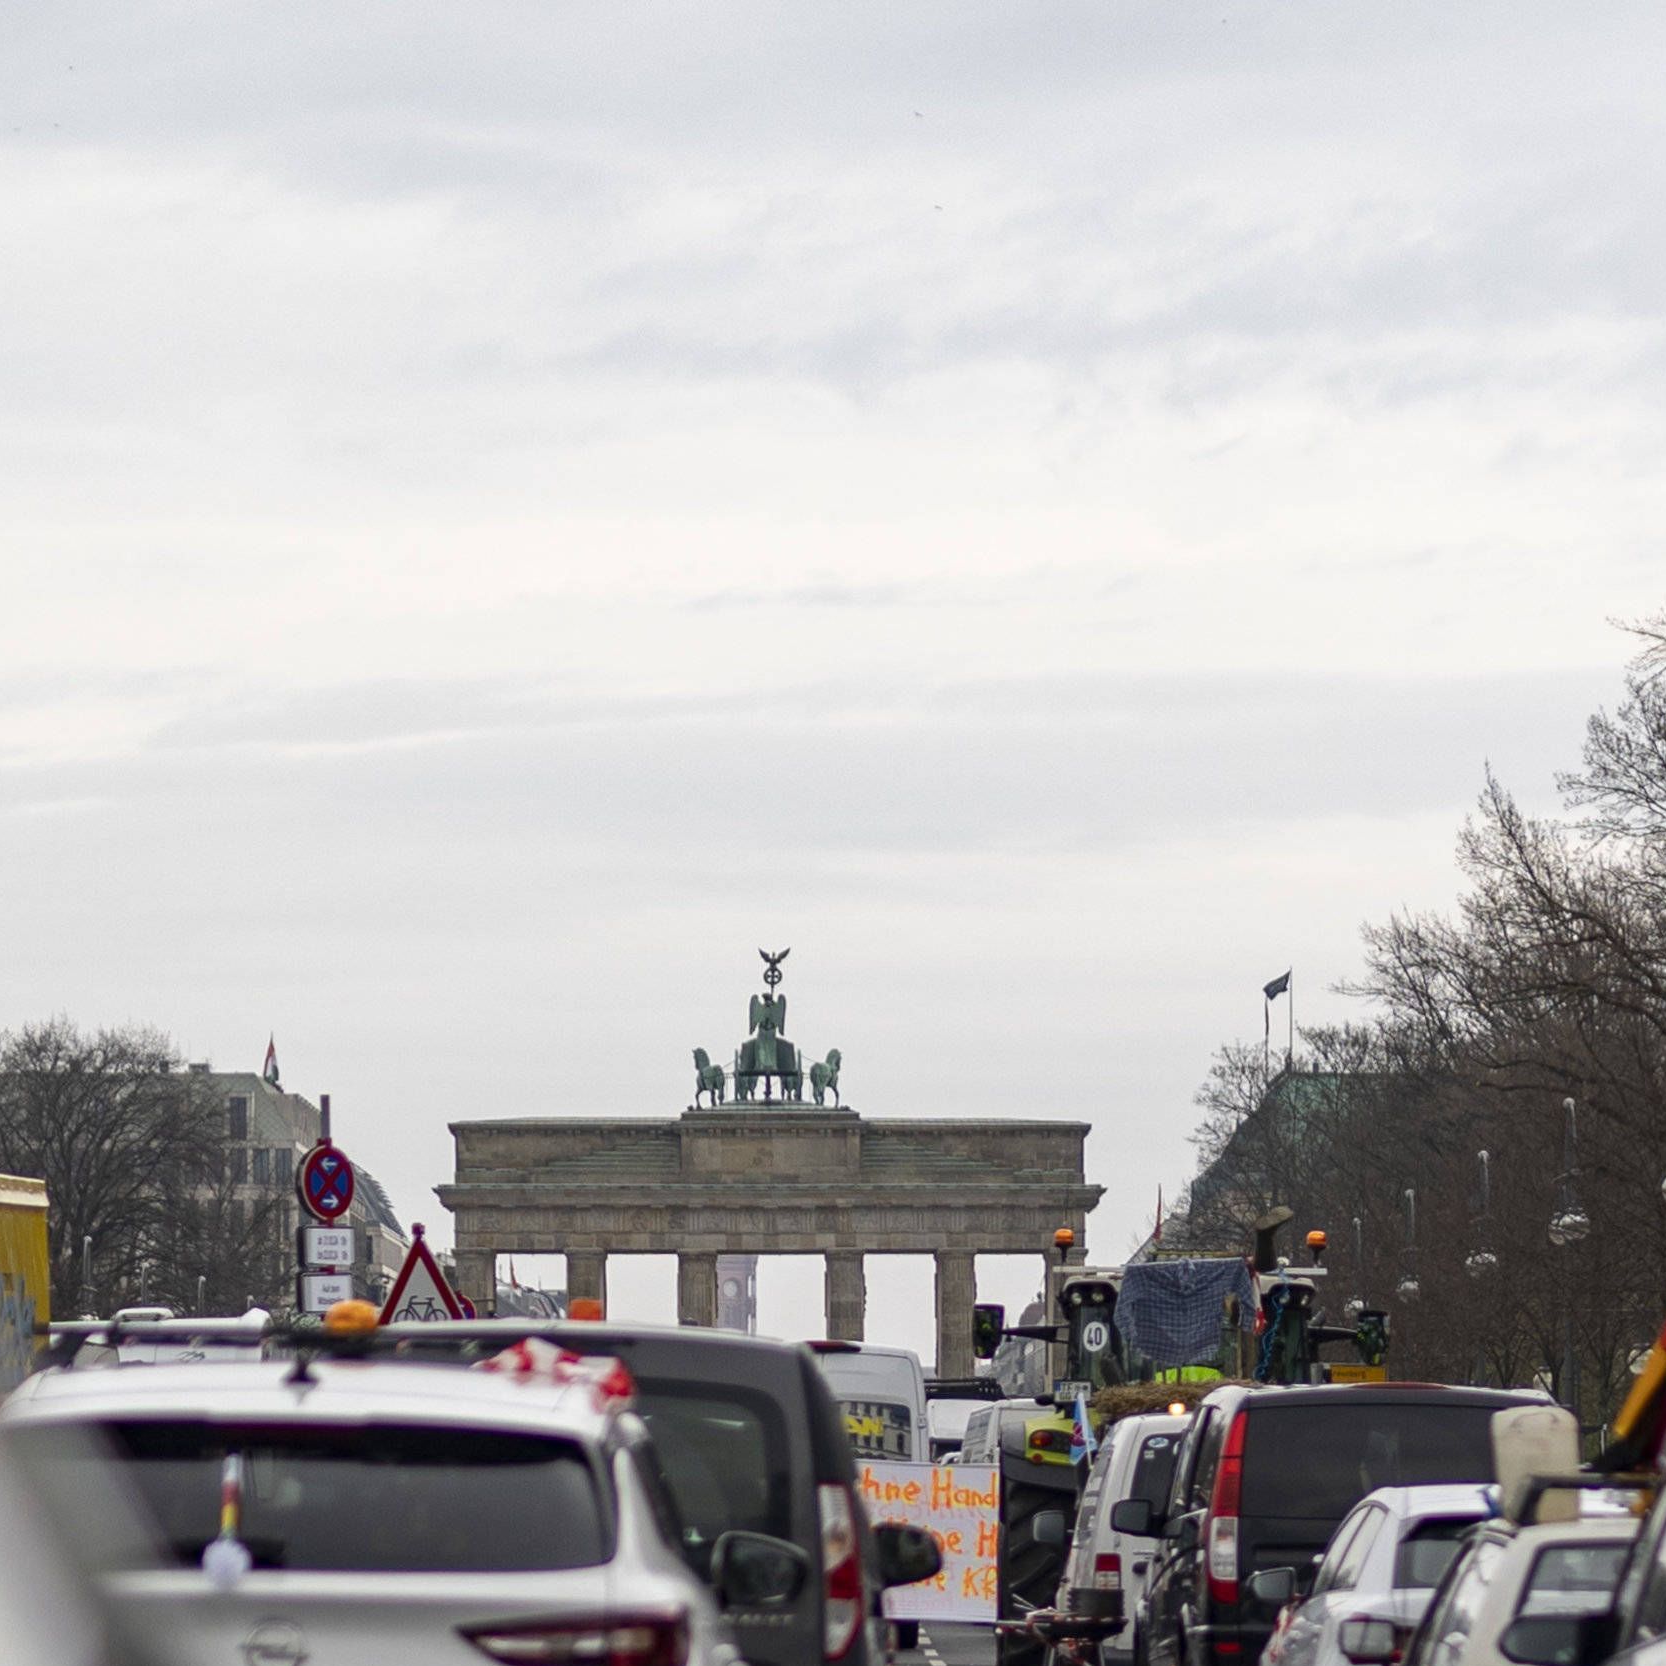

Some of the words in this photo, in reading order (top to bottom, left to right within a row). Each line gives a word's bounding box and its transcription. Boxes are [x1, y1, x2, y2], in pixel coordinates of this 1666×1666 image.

[1086, 1326, 1103, 1347] 40
[856, 1466, 922, 1504] hne
[930, 1467, 998, 1511] Hand
